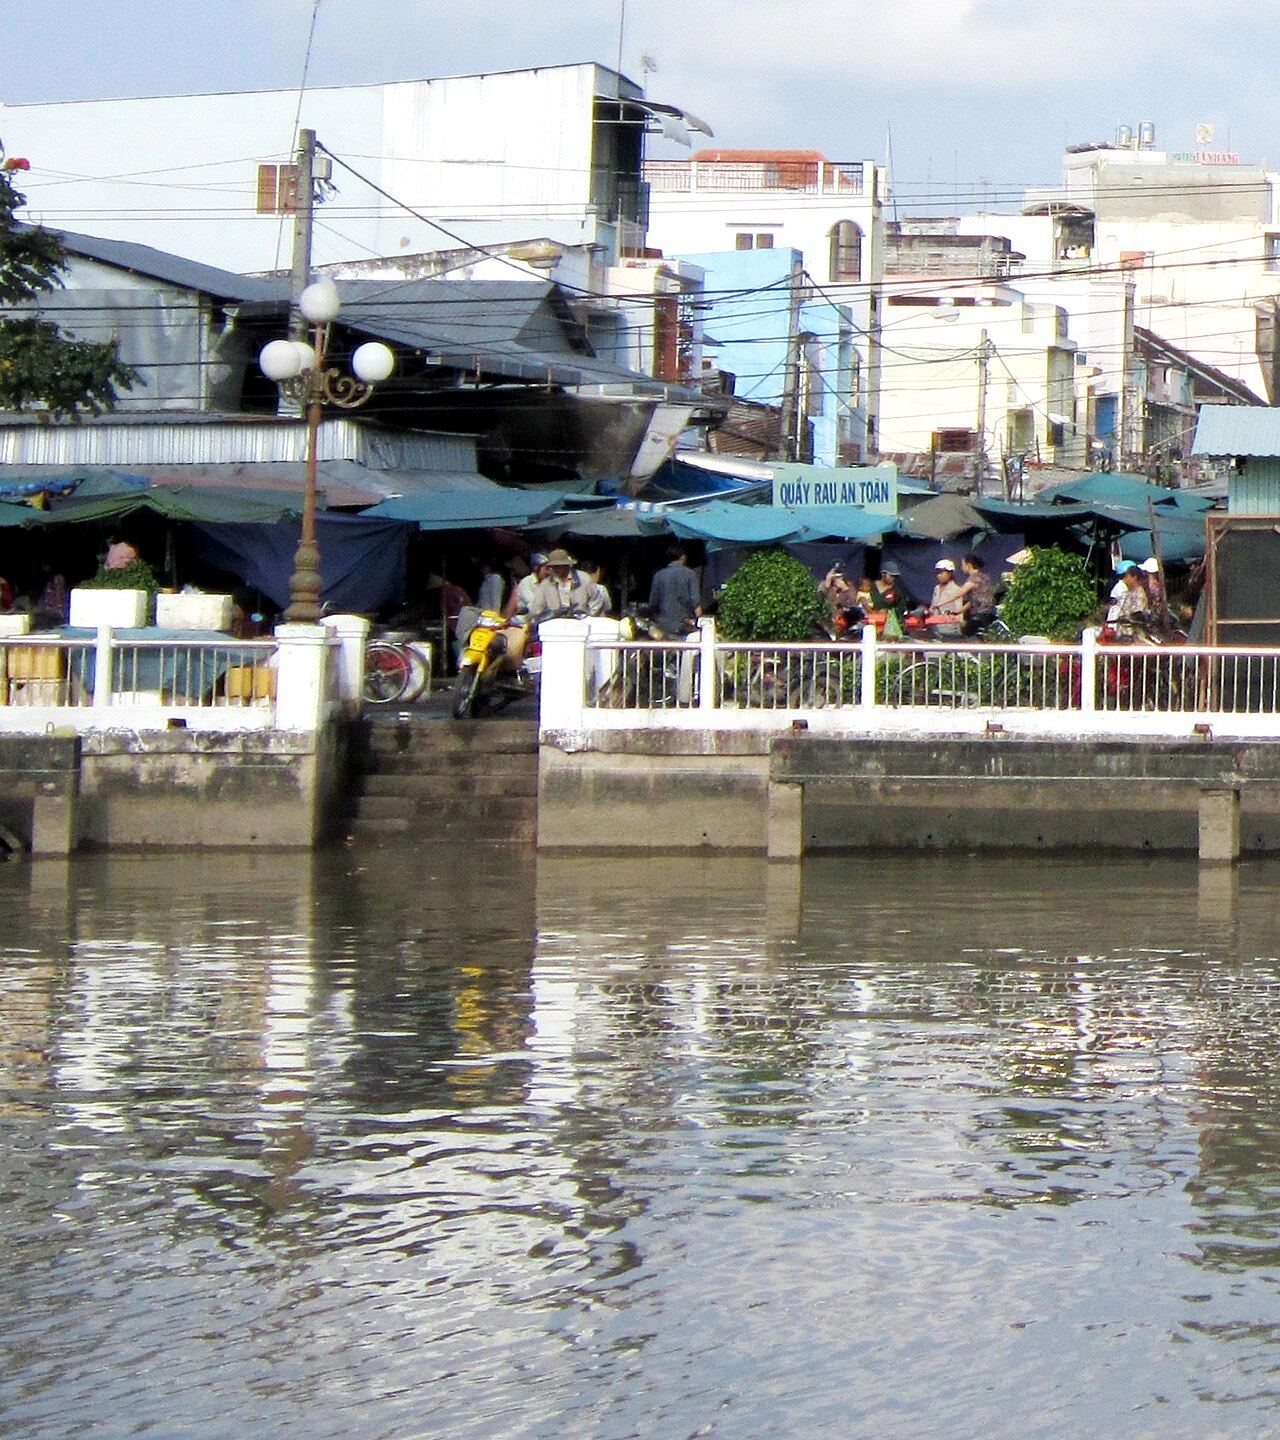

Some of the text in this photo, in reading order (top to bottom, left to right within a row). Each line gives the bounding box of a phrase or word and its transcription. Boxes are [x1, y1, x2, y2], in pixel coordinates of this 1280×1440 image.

[814, 482, 837, 505] RAU
[840, 481, 856, 503] AN
[859, 477, 889, 503] TOÀN
